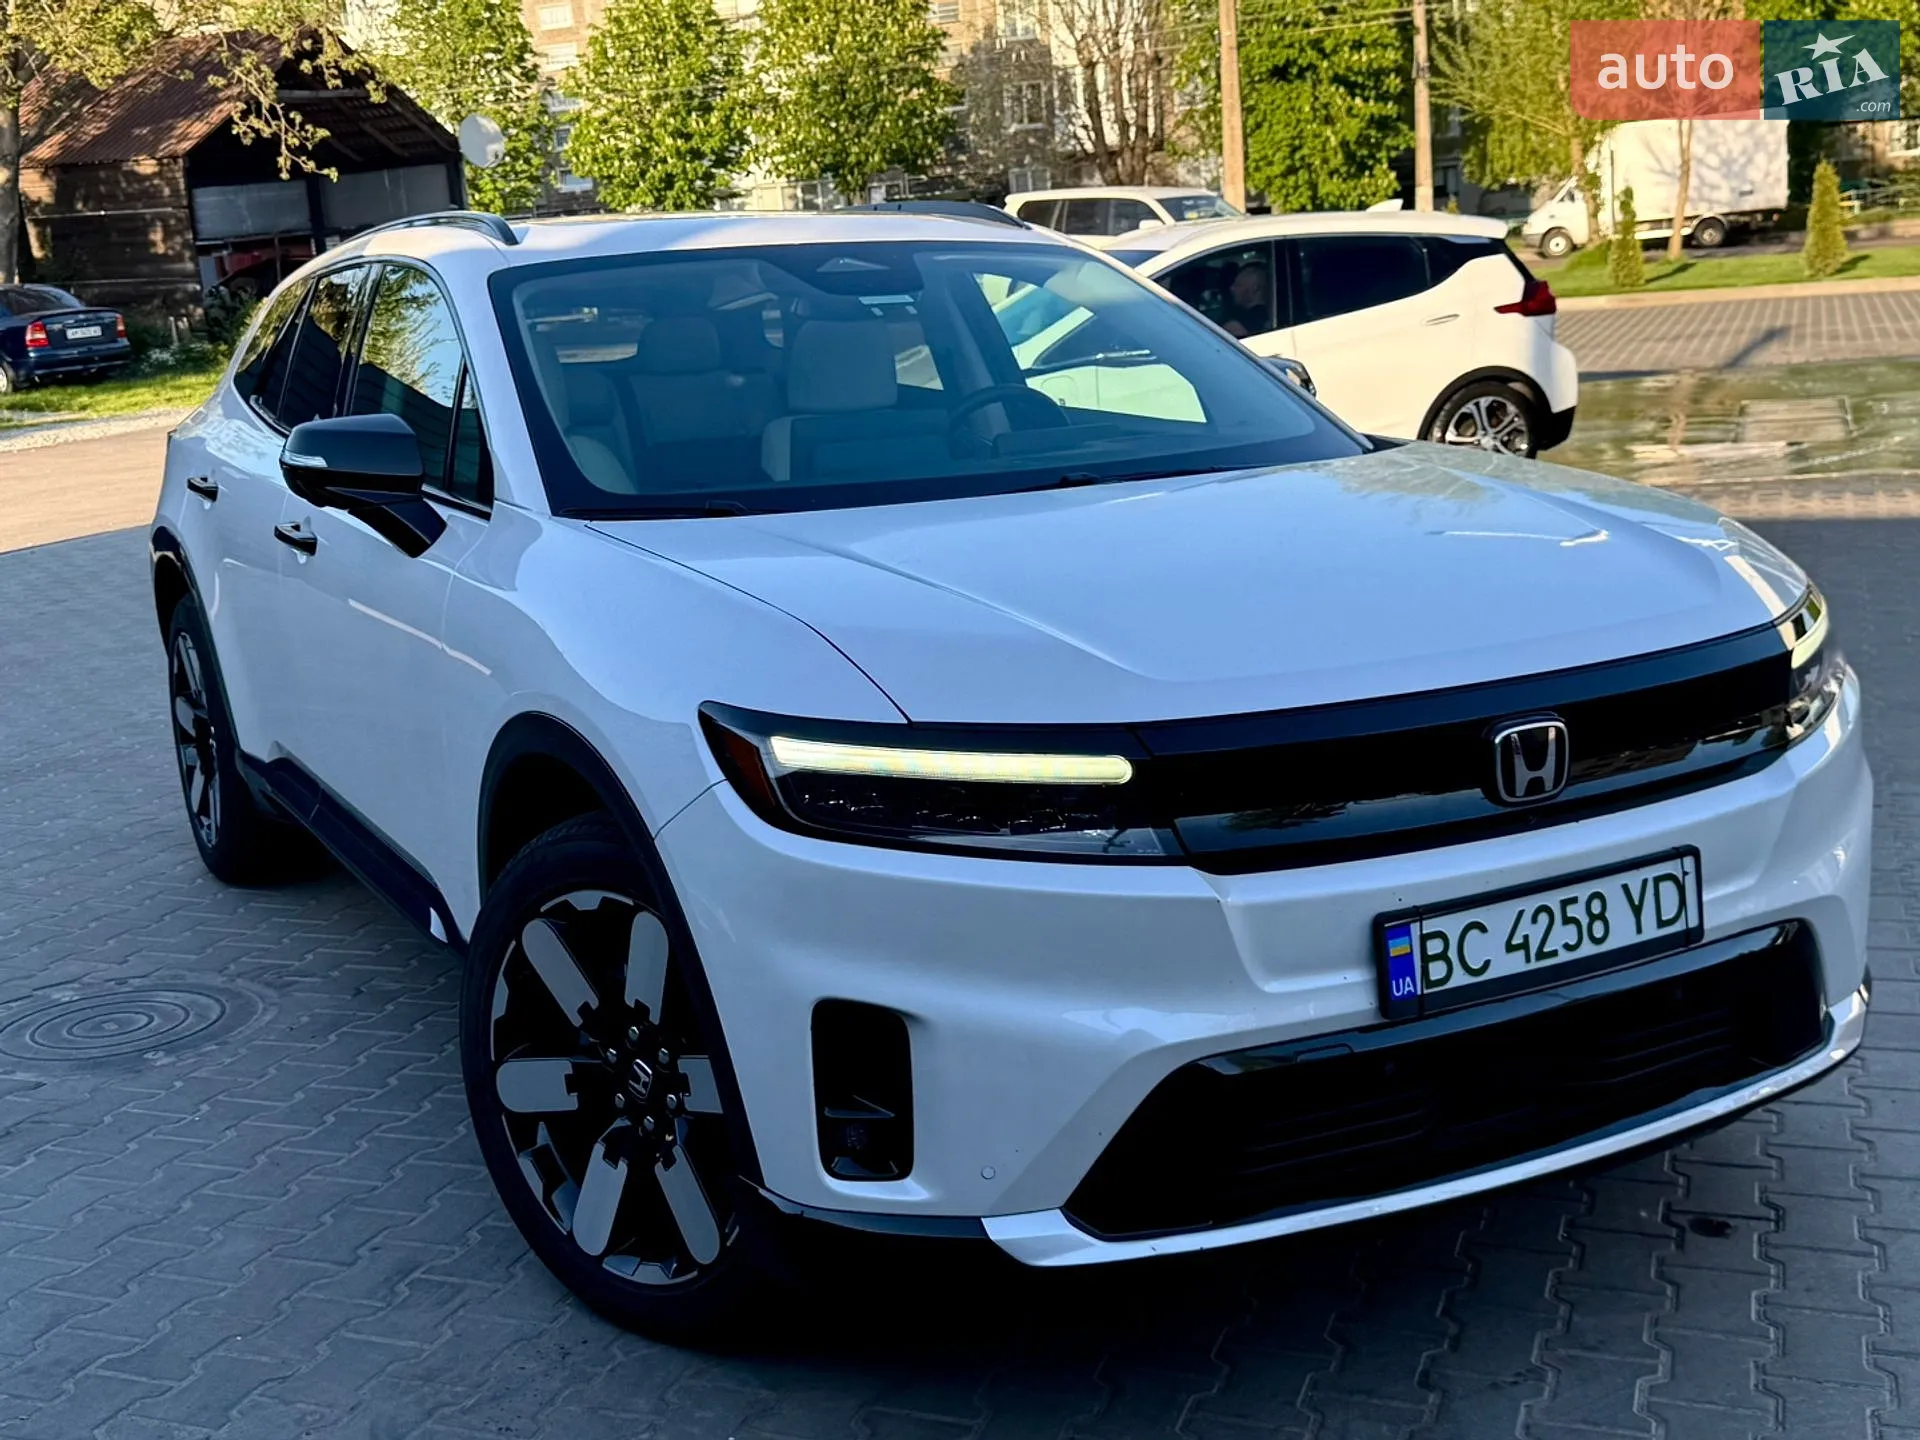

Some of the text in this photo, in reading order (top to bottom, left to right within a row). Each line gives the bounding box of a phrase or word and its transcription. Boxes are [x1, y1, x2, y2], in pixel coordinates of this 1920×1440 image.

[1421, 872, 1686, 990] BC 4258 YD
[1391, 976, 1415, 996] UA
